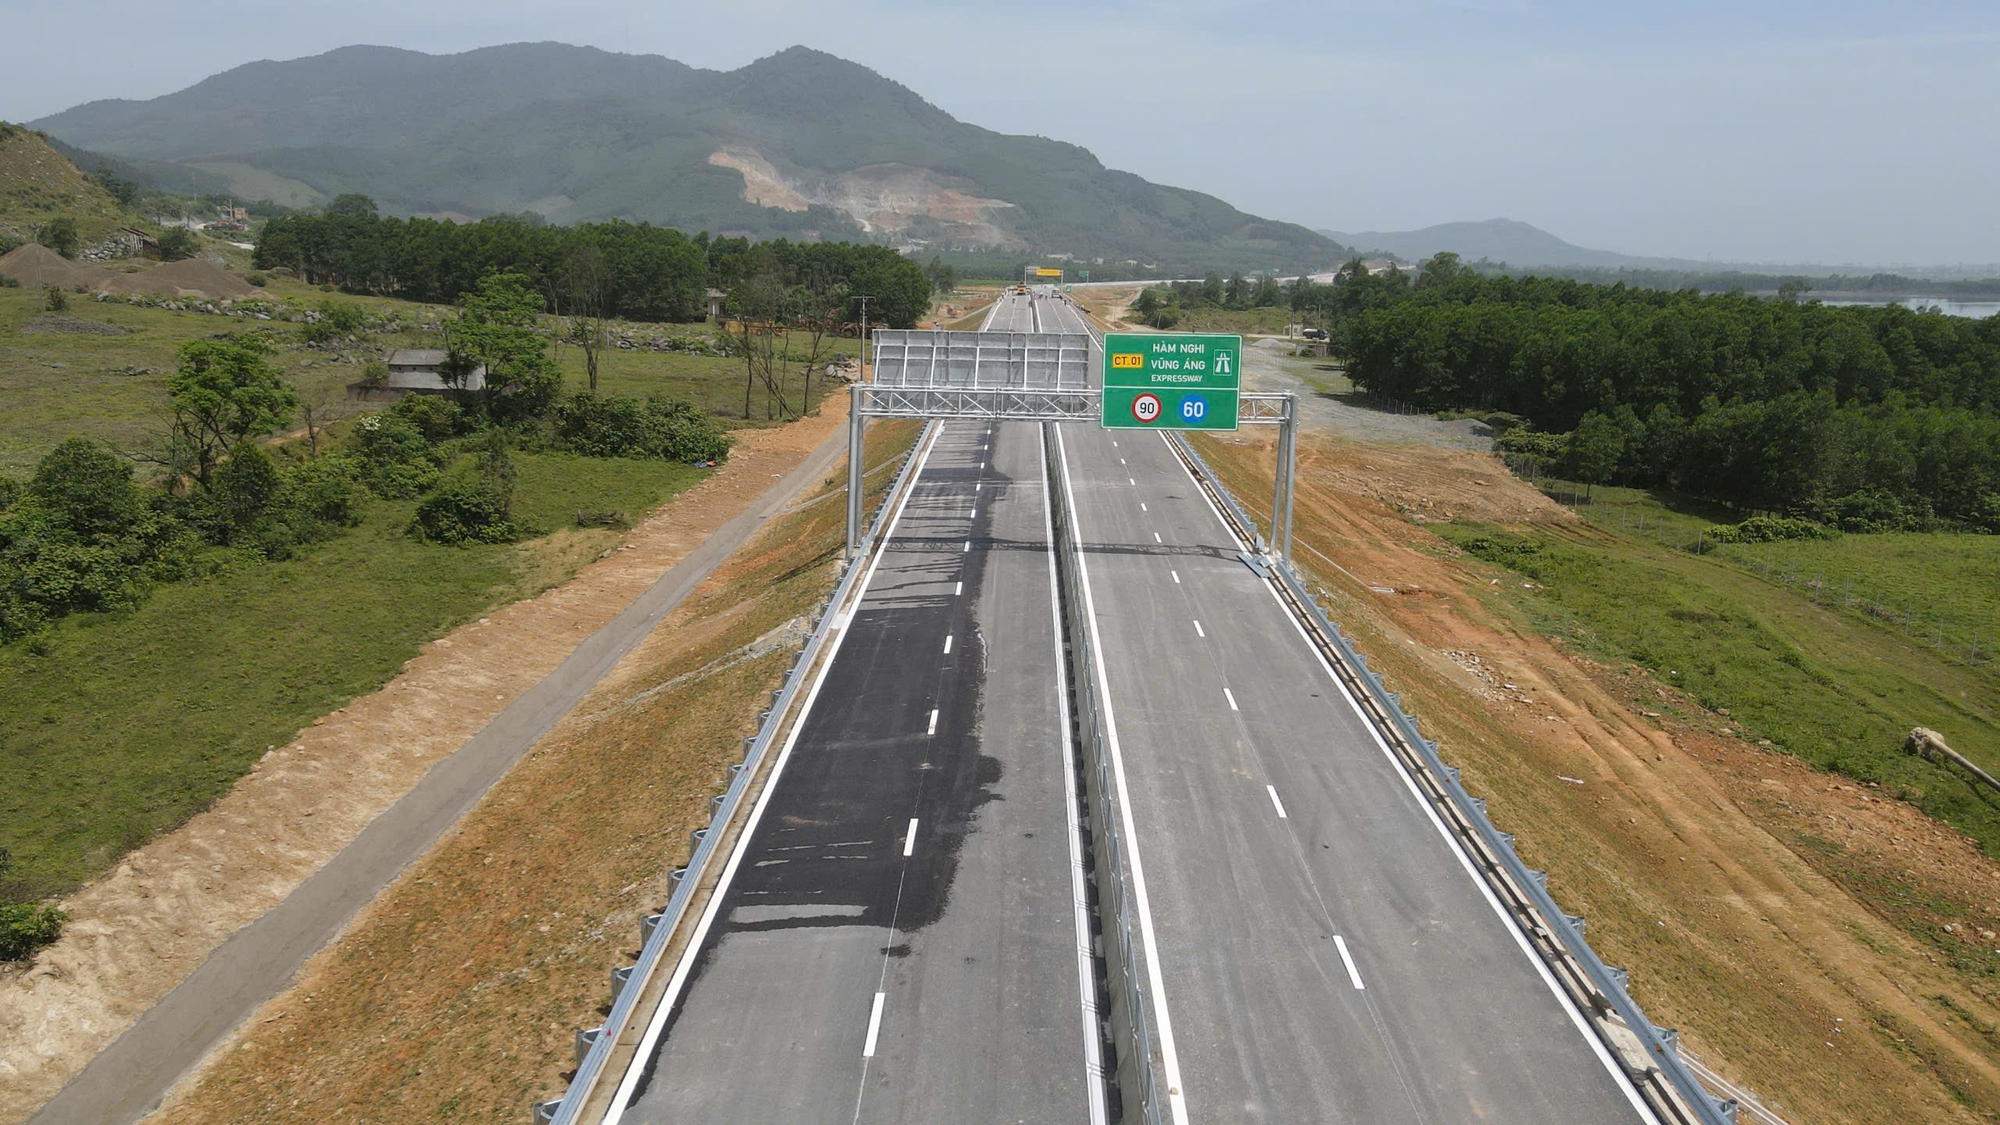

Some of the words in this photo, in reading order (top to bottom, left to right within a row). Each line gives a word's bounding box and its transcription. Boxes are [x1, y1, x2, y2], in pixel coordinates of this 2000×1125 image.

[1152, 340, 1176, 353] HÀM
[1180, 343, 1205, 354] NGHI
[1151, 357, 1179, 370] VŨNG
[1183, 358, 1205, 370] ÁNG
[1151, 374, 1203, 383] EXPRESSWAY
[1139, 402, 1155, 414] 90
[1183, 401, 1204, 418] 60
